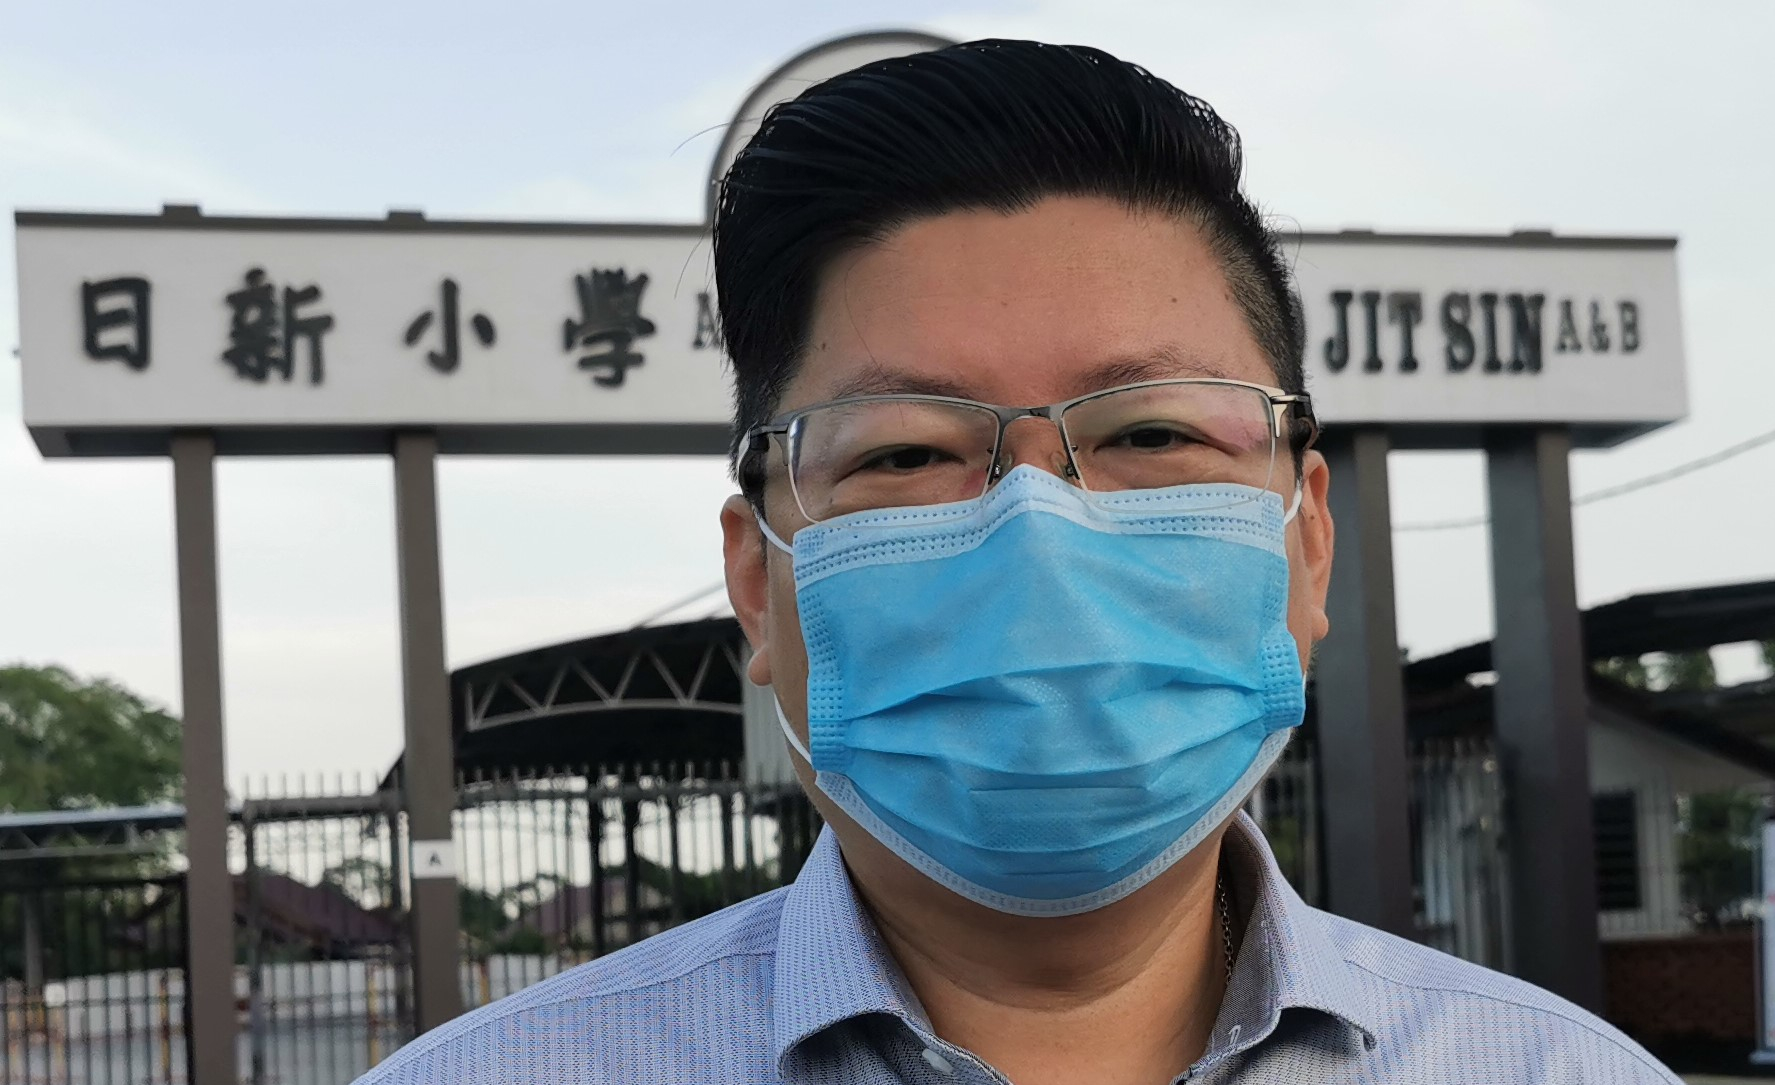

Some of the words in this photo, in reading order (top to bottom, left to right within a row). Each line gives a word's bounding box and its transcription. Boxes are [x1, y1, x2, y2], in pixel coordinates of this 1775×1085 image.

[80, 267, 655, 389] 日新小學
[1324, 290, 1422, 373] JIT
[1441, 293, 1546, 374] SIN
